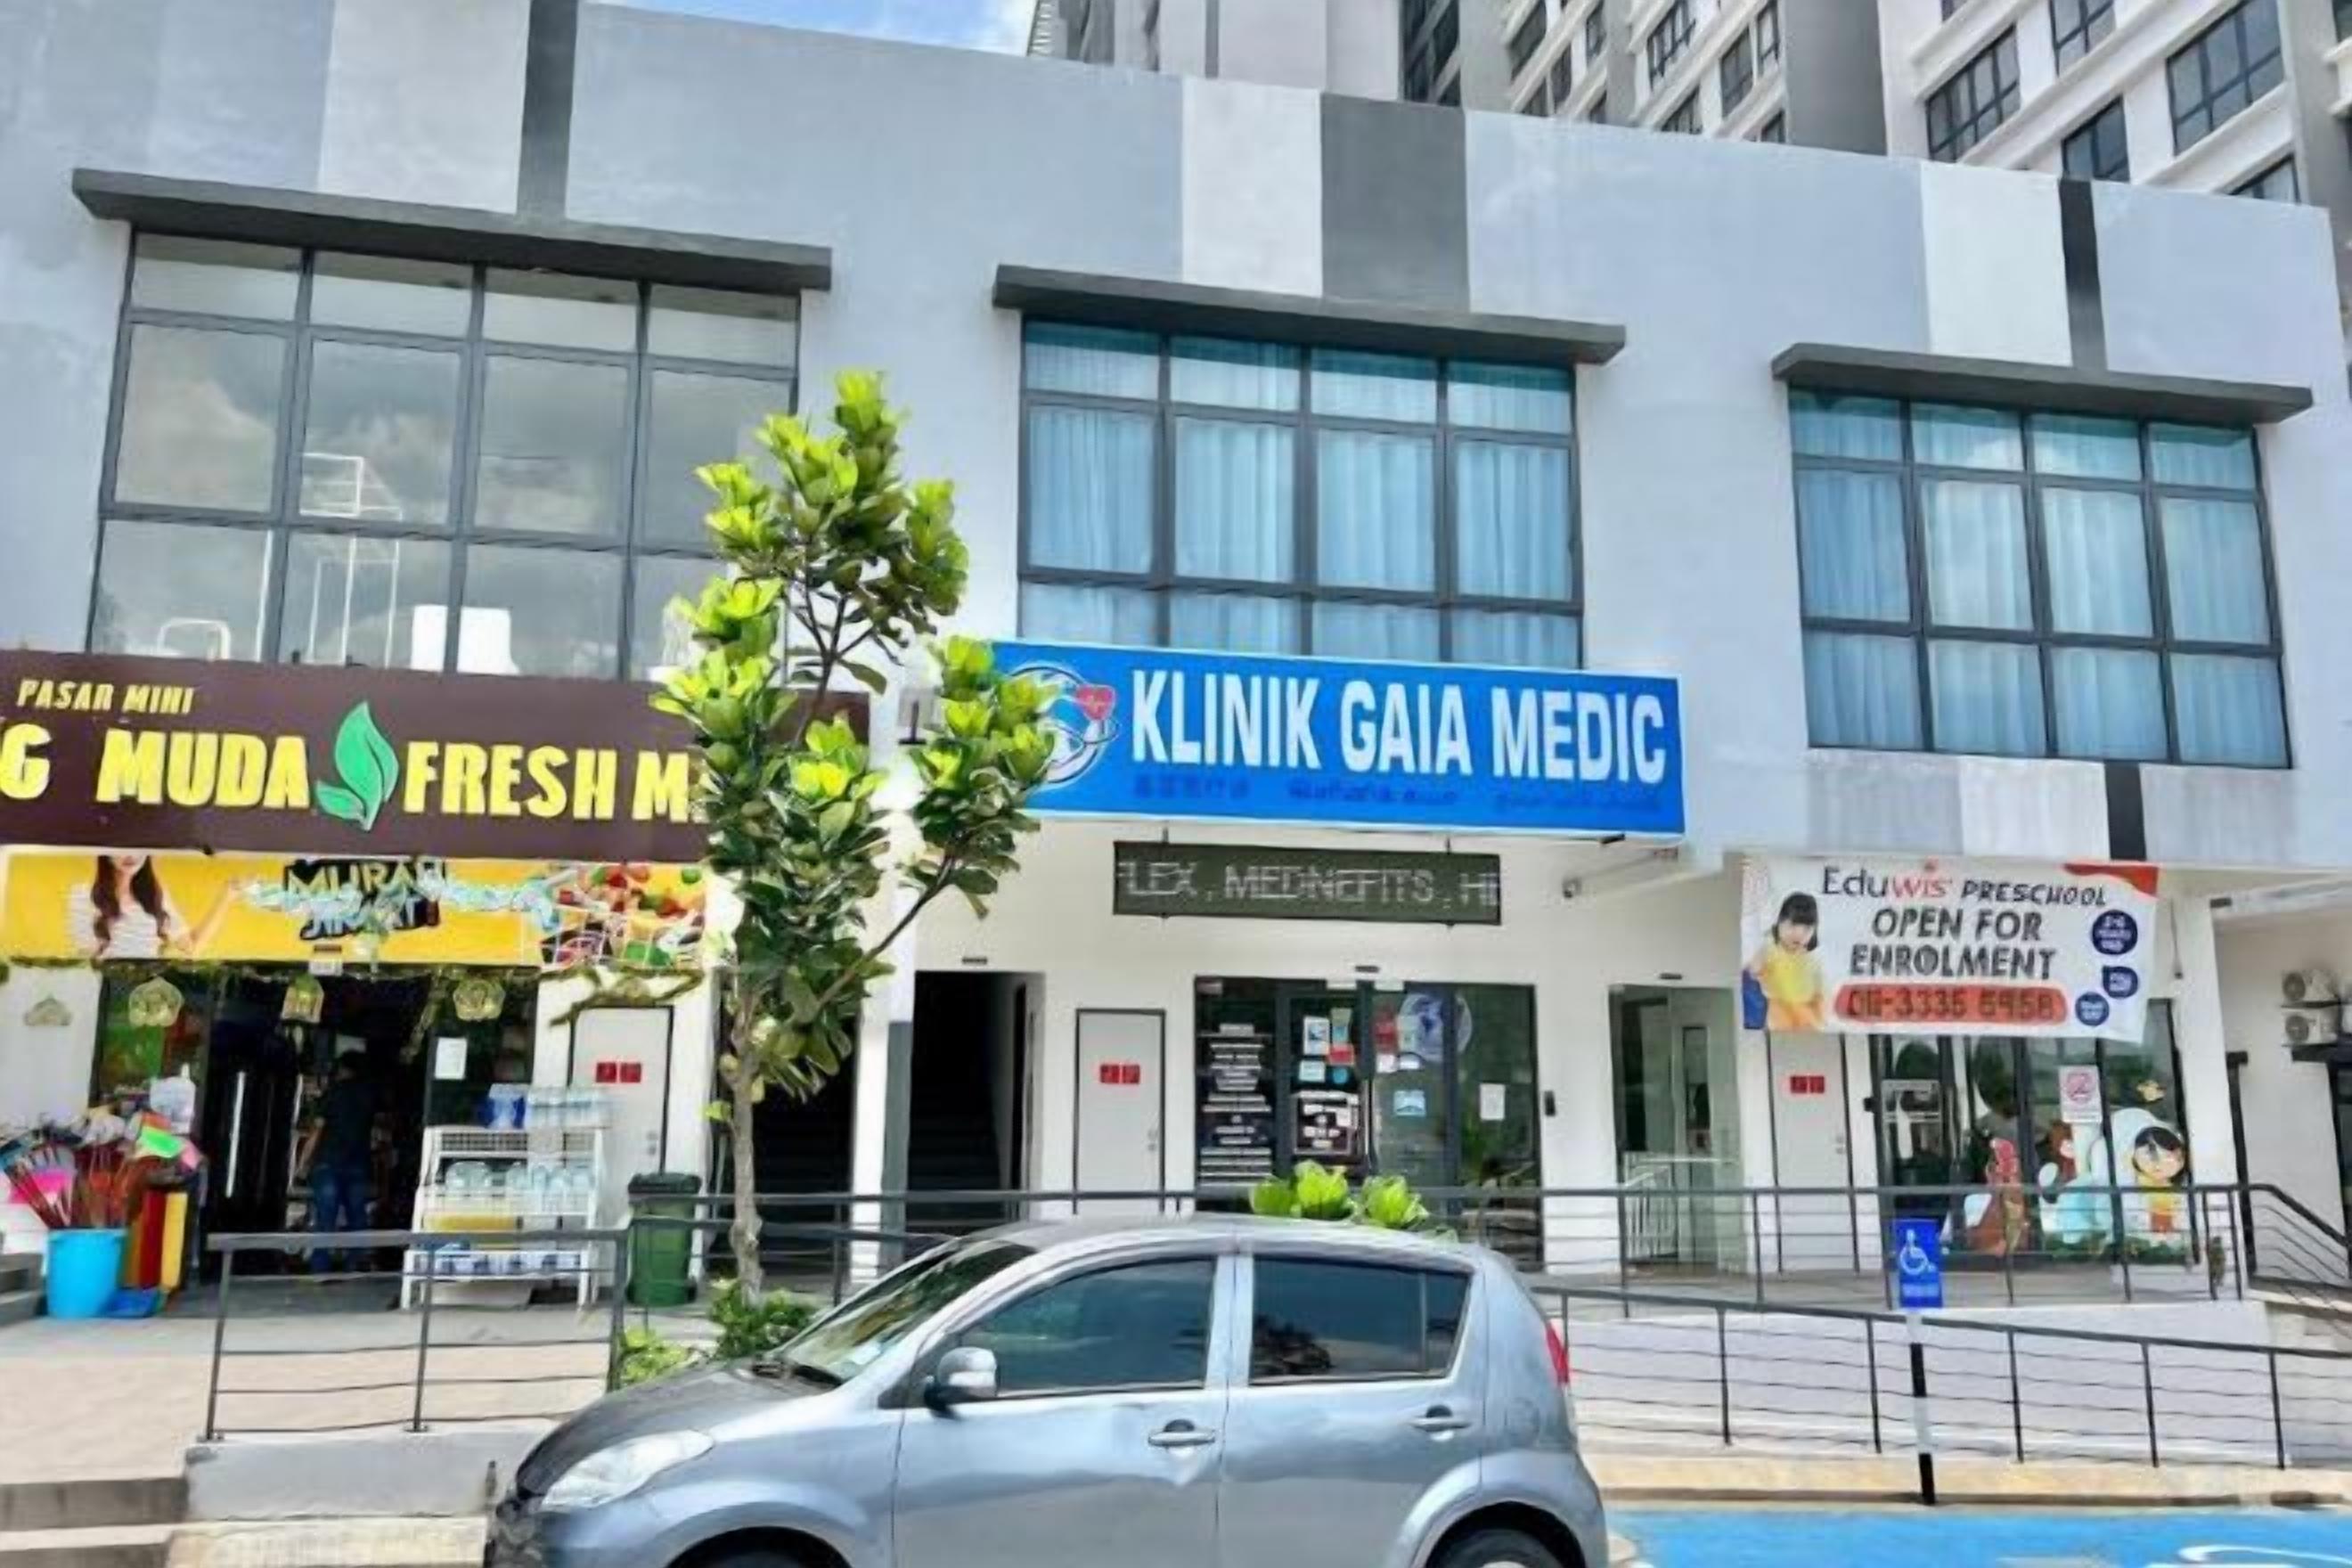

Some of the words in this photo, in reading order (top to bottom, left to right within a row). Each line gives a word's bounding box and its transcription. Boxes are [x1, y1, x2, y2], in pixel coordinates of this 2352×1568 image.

[16, 679, 115, 710] PASAR
[121, 683, 195, 715] MINI
[1132, 669, 1321, 772] KLINIK
[1340, 680, 1474, 777] GAIA
[1491, 686, 1667, 784] MEDIC
[96, 728, 311, 810] MUDA
[403, 739, 616, 821] FRESH
[1961, 878, 2106, 906] PRESCHOOL
[1872, 907, 1964, 941] OPEN
[1974, 909, 2043, 942] FOR
[1850, 943, 2057, 980] ENROLMENT
